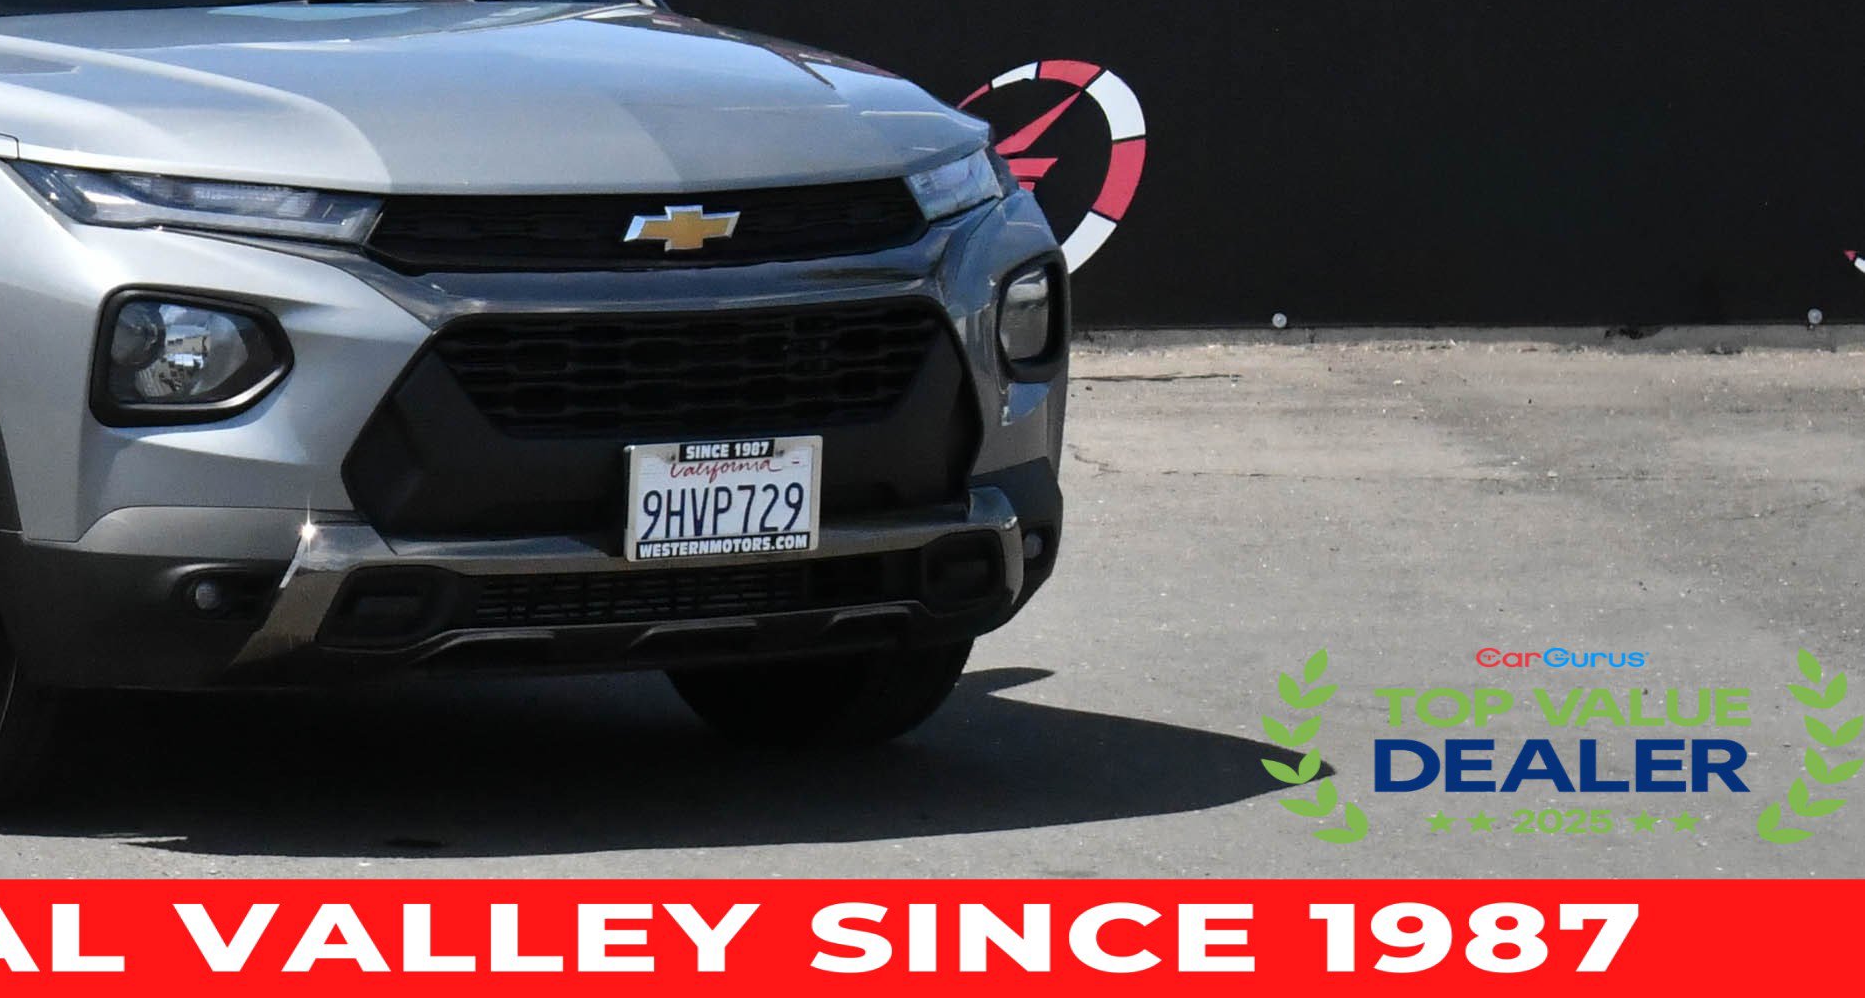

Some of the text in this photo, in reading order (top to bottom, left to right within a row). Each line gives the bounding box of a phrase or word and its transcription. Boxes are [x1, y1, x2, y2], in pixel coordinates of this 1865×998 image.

[686, 441, 769, 460] SINCE 1987
[670, 459, 782, 483] California
[641, 483, 804, 540] 9HVP729
[639, 534, 808, 559] WESTERNMOTORS.COM
